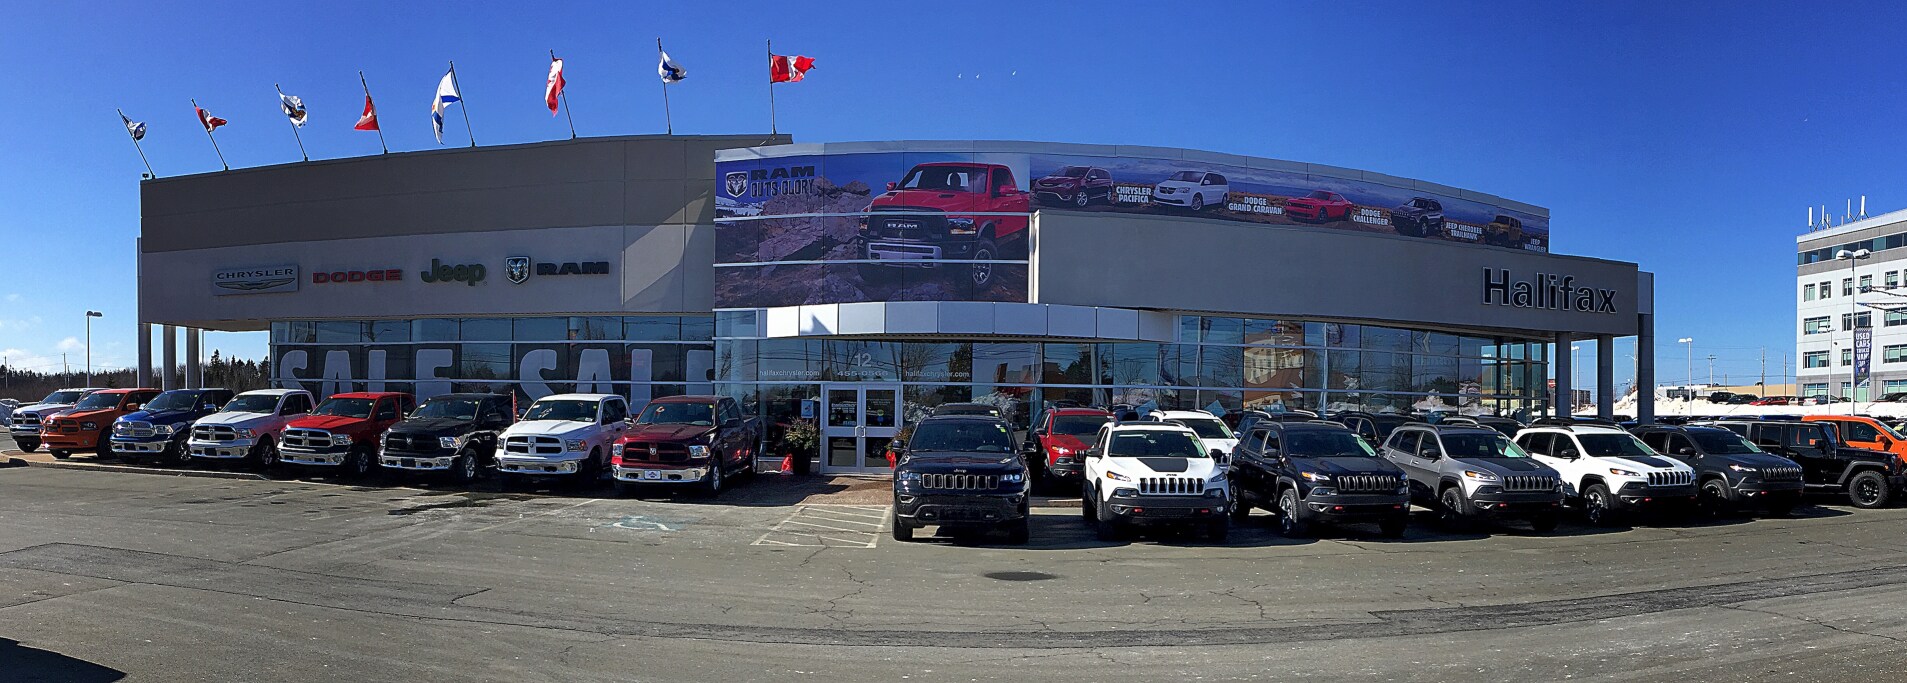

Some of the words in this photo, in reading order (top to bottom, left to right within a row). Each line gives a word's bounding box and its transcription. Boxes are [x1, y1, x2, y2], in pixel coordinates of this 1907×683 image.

[751, 166, 815, 180] RAM
[1116, 186, 1152, 196] CHRYSLER
[1118, 194, 1149, 204] PACIFICA
[1244, 196, 1267, 206] DODGE
[1228, 203, 1251, 212] GRAND
[1253, 205, 1282, 215] CARAVAN
[1361, 208, 1381, 218] DODGE
[1353, 215, 1389, 226] CHALLENGER
[1445, 222, 1458, 230] JEEP
[216, 268, 294, 280] CHRYSLER
[420, 258, 487, 287] Jeep
[536, 261, 610, 276] RAM
[312, 268, 403, 284] DODGE
[1482, 266, 1618, 314] Halifax
[1855, 332, 1870, 340] USED
[854, 352, 872, 367] 12
[759, 369, 820, 378] halifaxchrysler.com
[905, 370, 970, 379] halifaxchrysler.com
